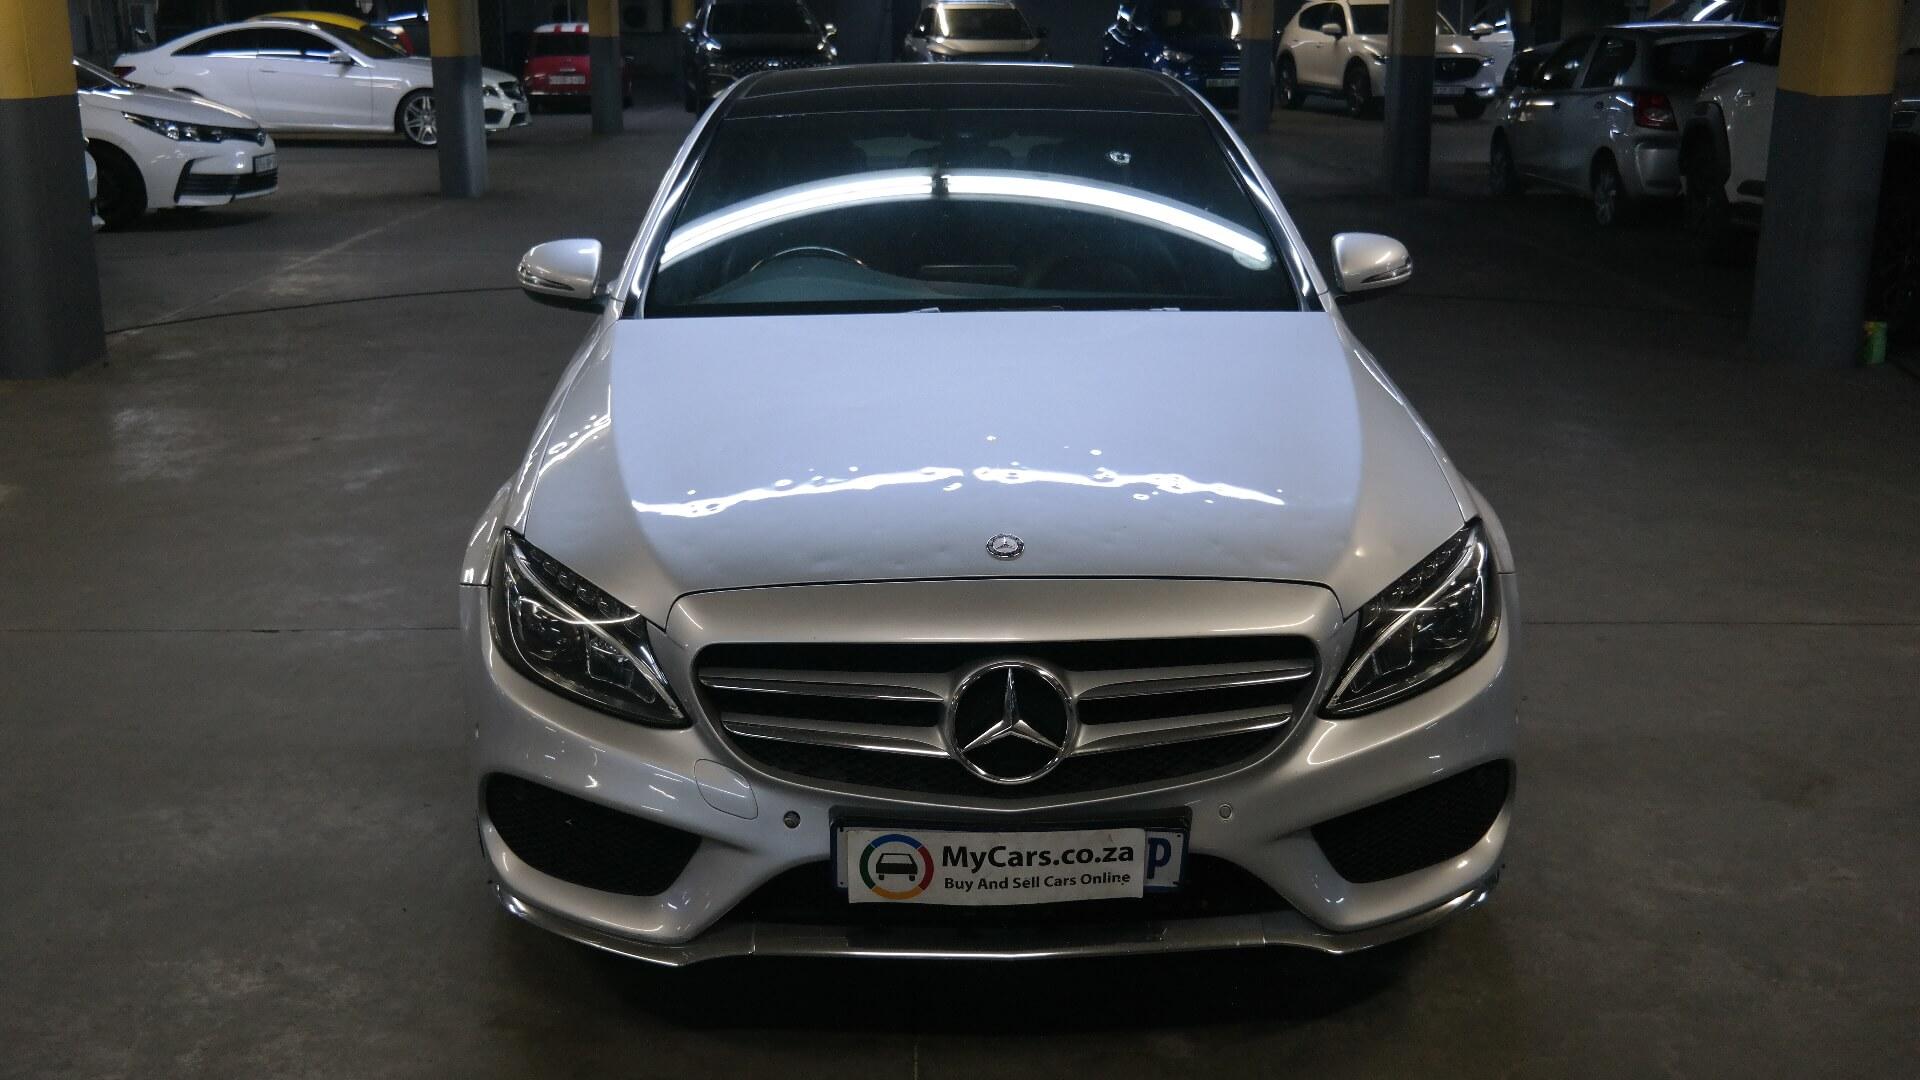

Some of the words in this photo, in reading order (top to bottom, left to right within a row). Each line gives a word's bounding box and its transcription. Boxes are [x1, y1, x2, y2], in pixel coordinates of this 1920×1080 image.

[942, 846, 1134, 874] MyCars.co.za
[944, 877, 974, 893] Buy
[977, 877, 1009, 890] And
[1012, 876, 1040, 889] Sell
[1044, 875, 1077, 888] Cars
[1080, 872, 1131, 885] Online
